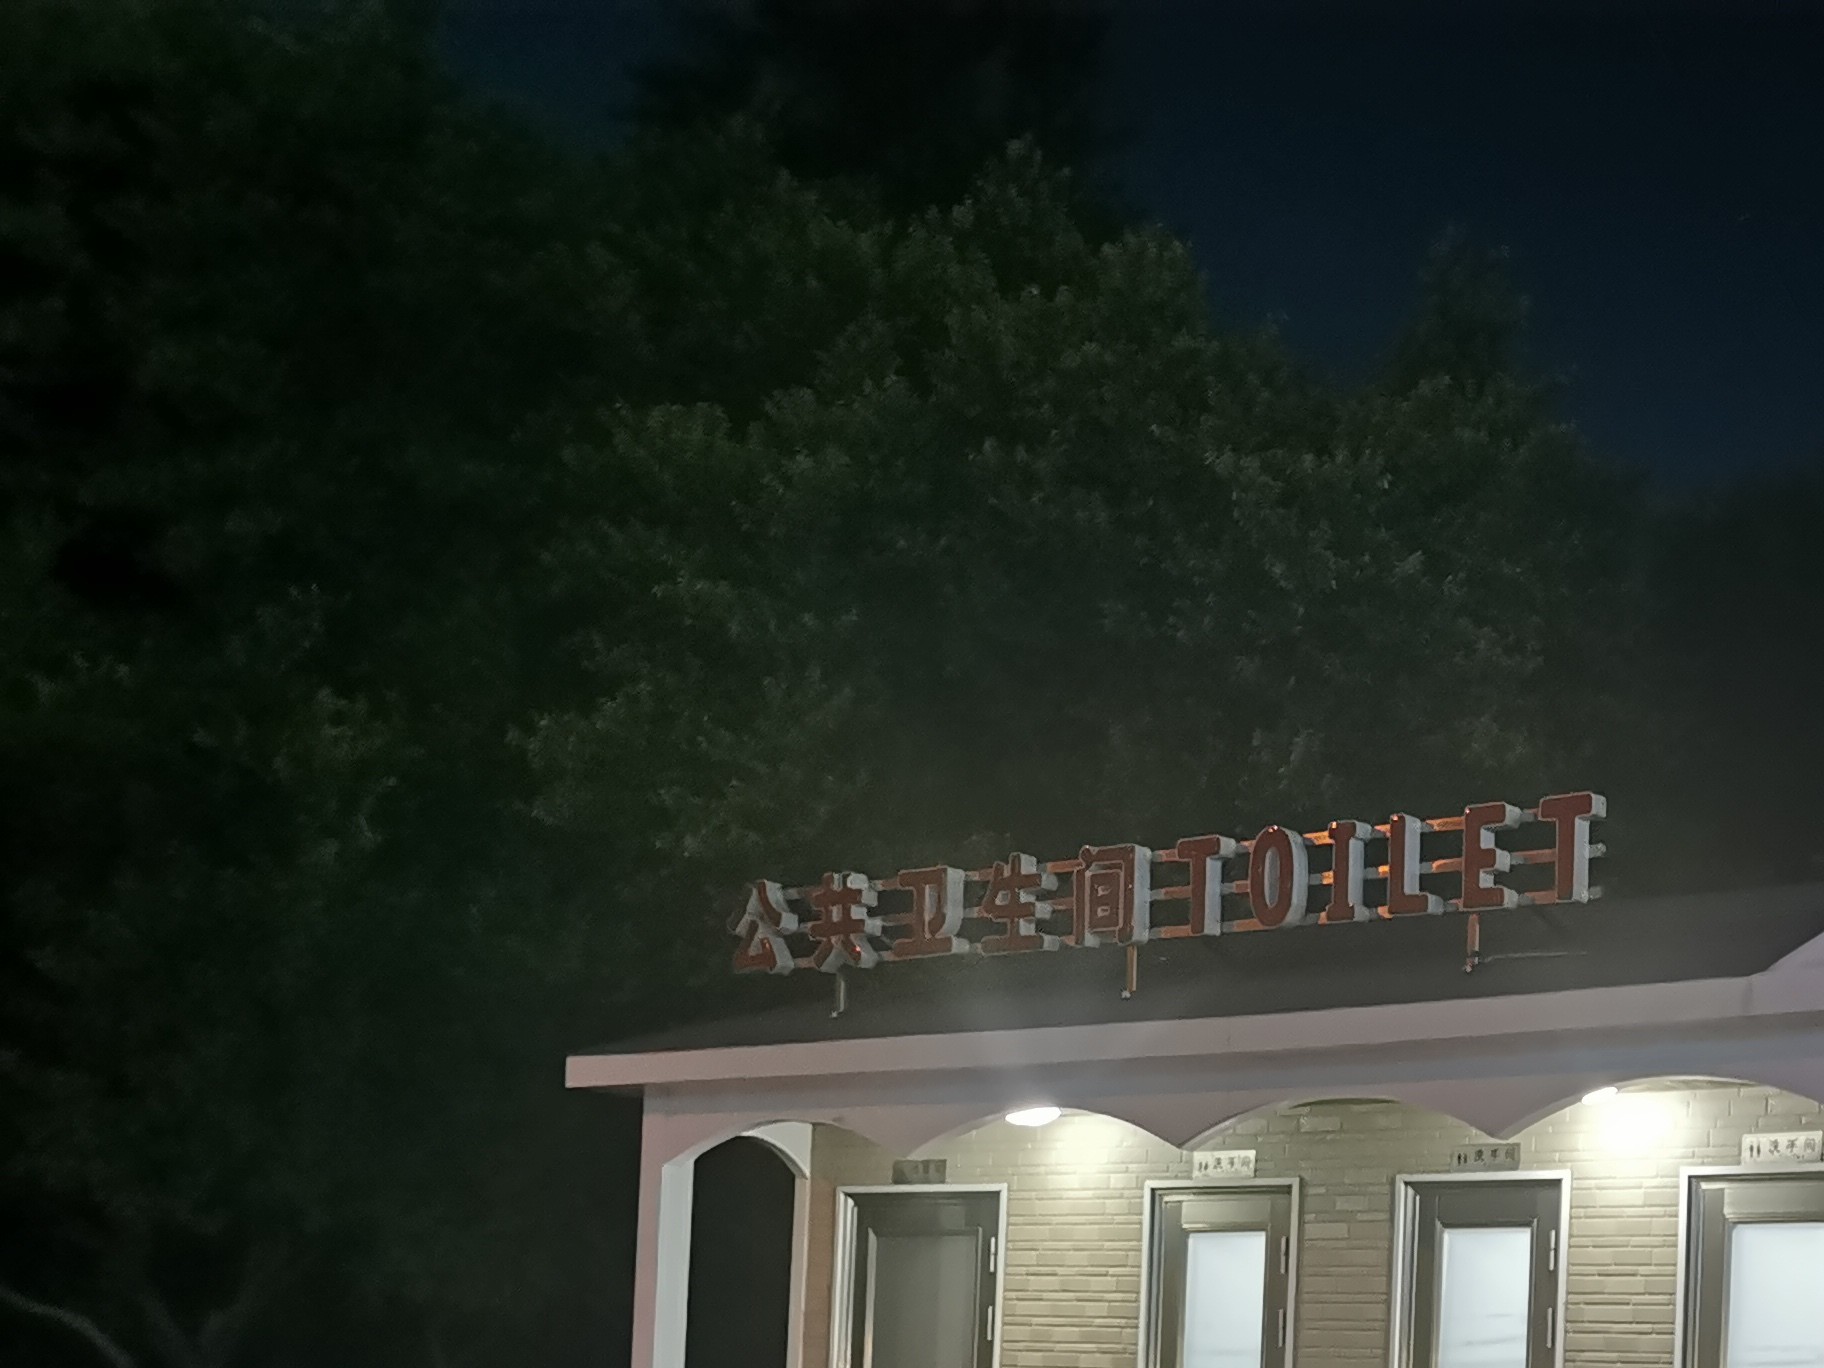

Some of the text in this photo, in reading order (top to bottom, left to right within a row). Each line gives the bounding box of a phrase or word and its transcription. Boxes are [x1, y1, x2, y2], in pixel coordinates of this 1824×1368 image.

[733, 845, 1151, 974] 公共卫生间
[1178, 793, 1606, 936] TOILET
